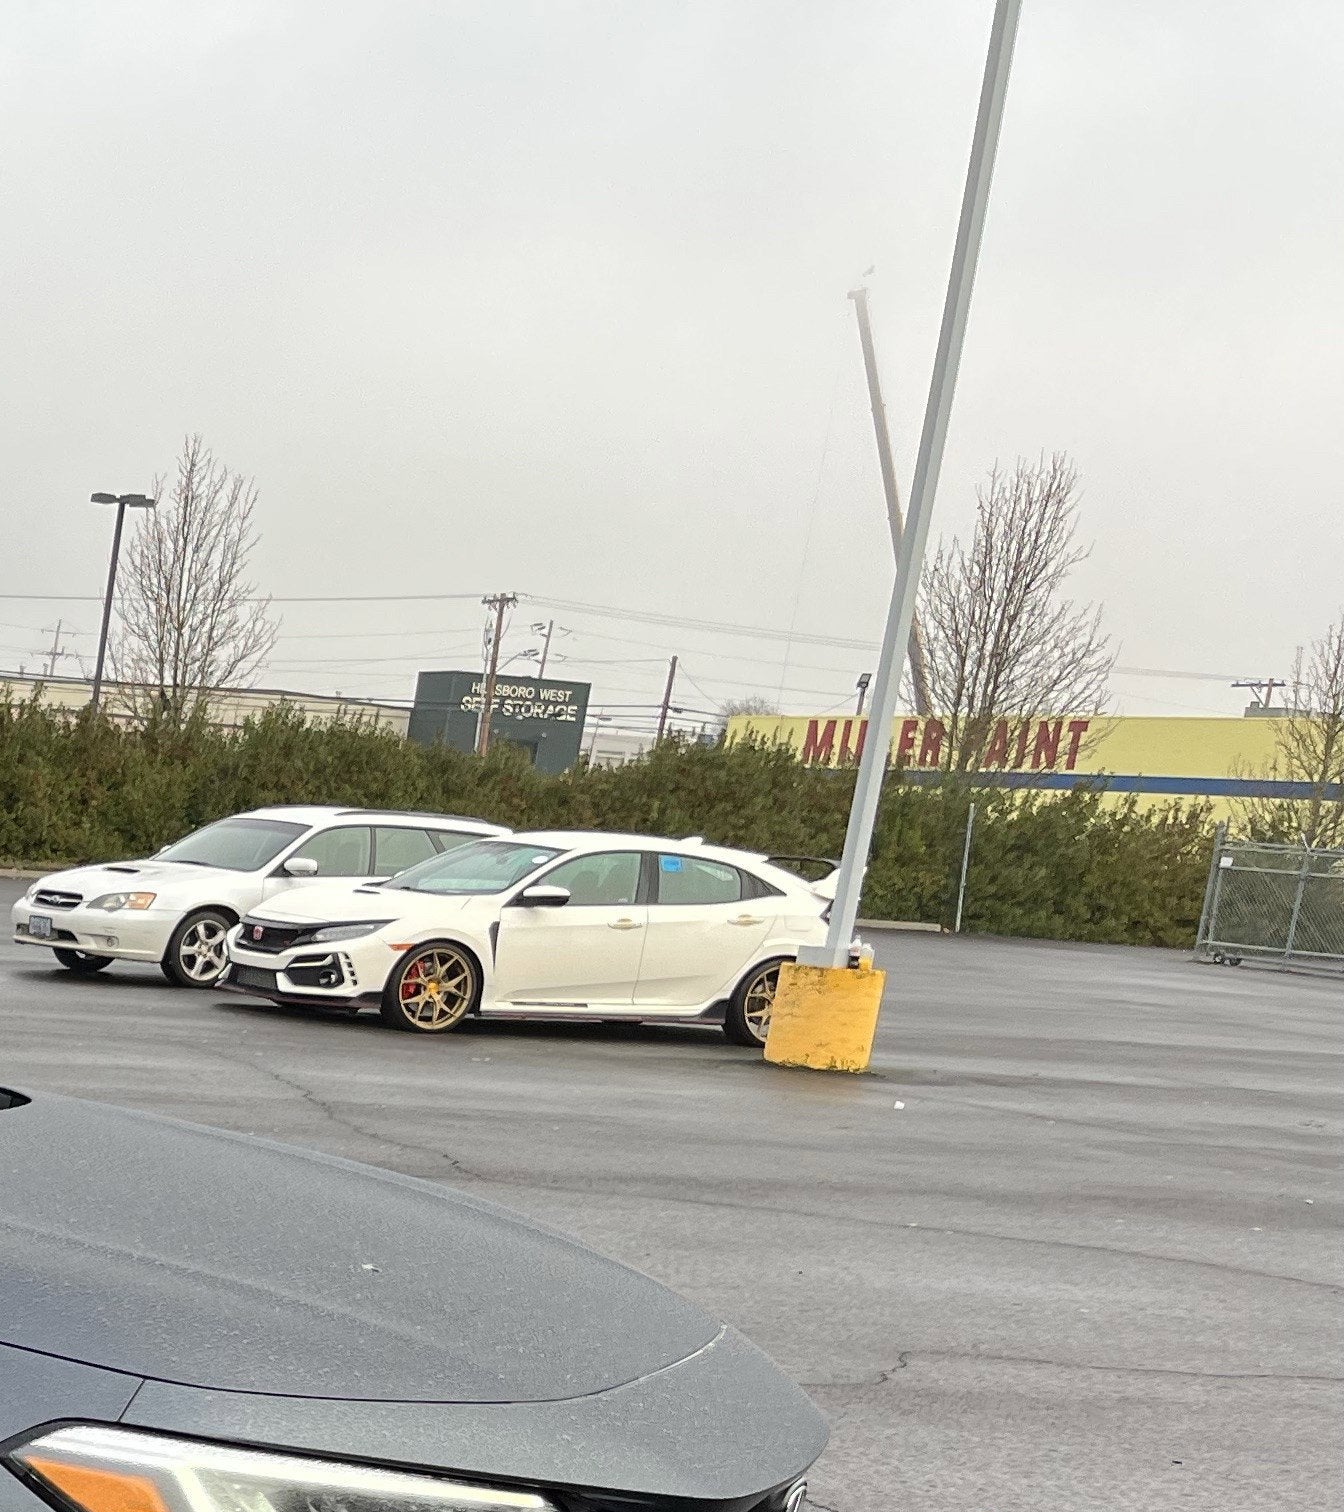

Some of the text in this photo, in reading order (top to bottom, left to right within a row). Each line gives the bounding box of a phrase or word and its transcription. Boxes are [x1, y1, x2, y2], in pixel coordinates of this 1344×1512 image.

[471, 681, 573, 702] HSBORO WEST
[460, 695, 500, 714] SEF
[801, 718, 1090, 771] MIER AINT
